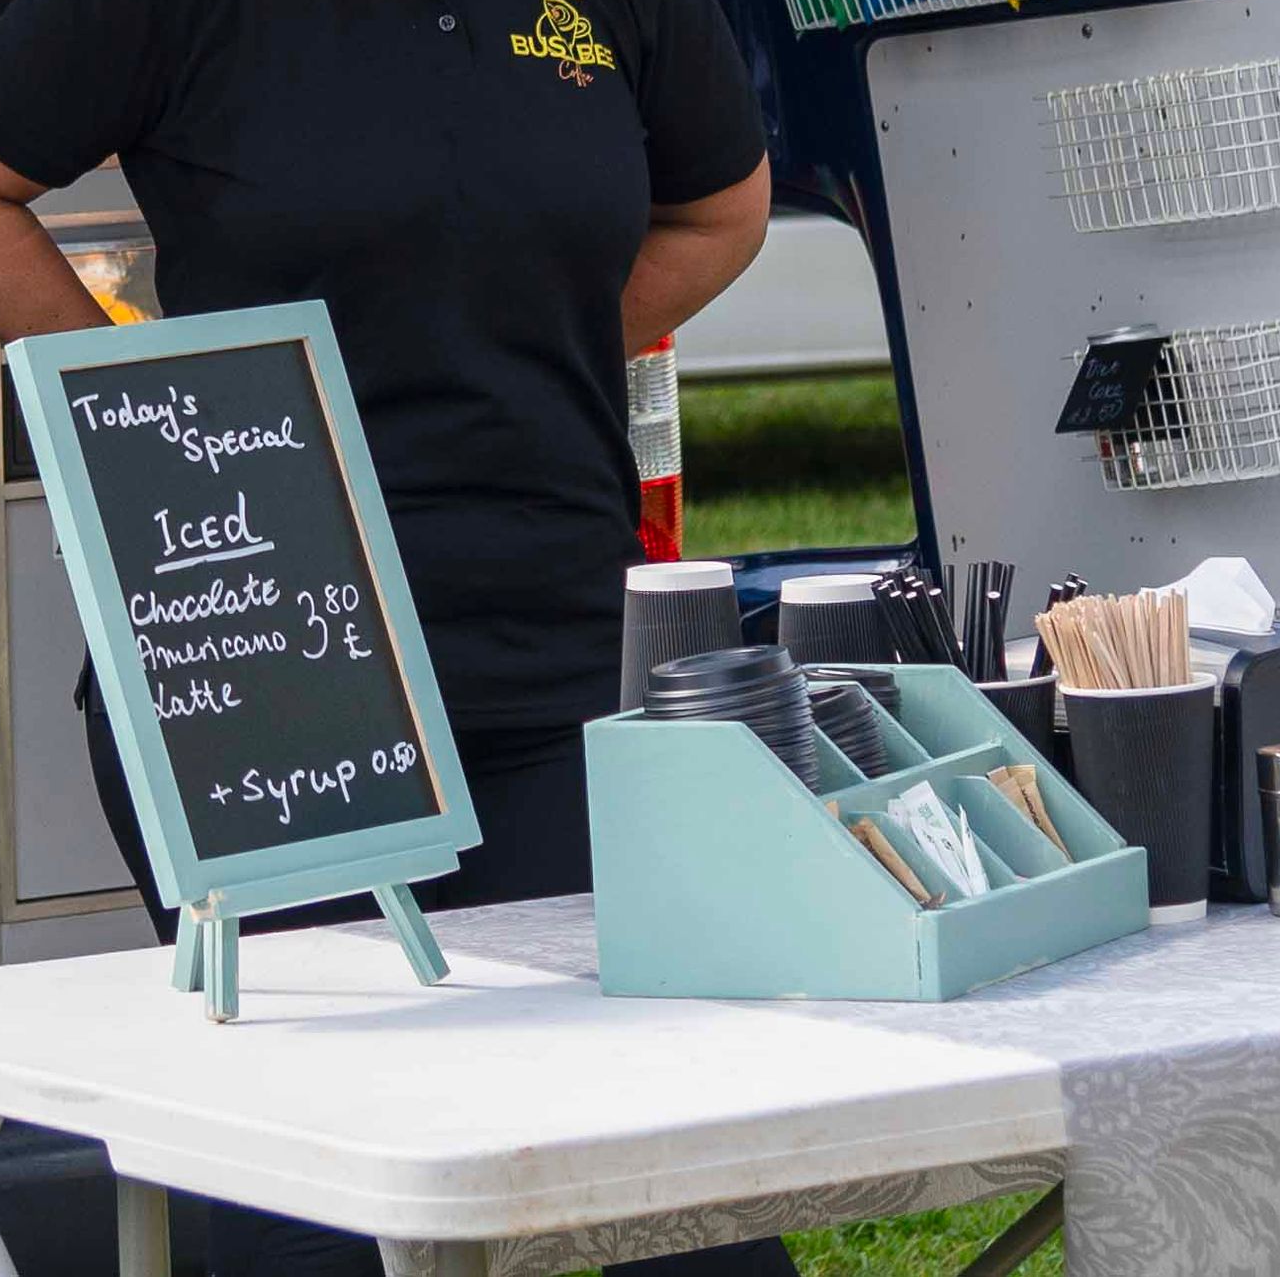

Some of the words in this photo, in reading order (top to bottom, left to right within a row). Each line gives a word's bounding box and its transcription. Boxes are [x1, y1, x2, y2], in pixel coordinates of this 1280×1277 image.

[72, 387, 198, 443] Today's
[136, 630, 287, 672] Americano
[241, 760, 357, 824] Syrup
